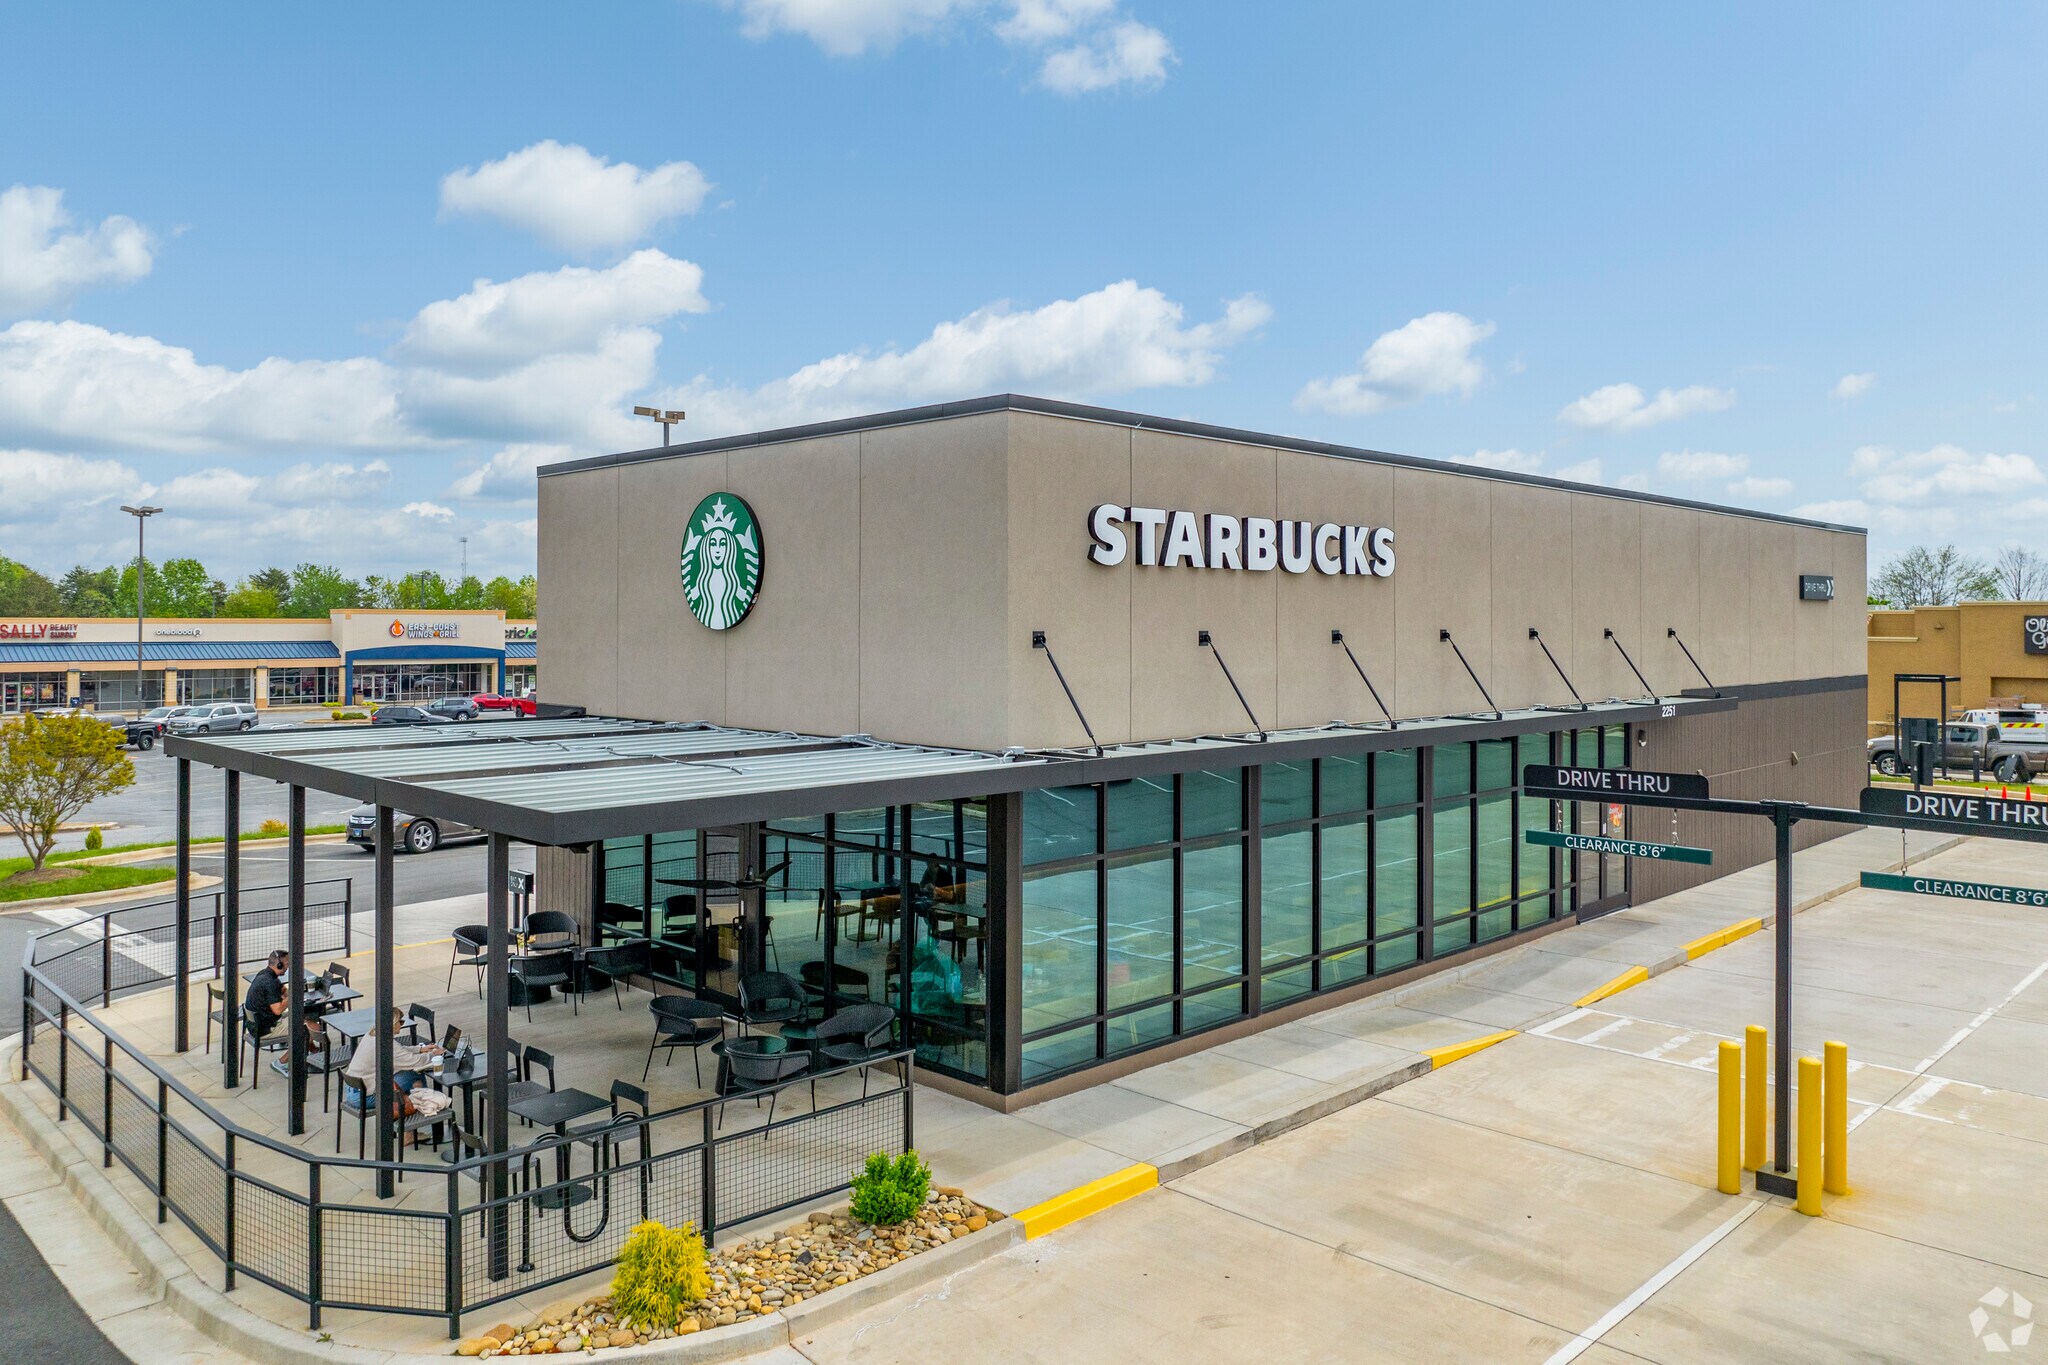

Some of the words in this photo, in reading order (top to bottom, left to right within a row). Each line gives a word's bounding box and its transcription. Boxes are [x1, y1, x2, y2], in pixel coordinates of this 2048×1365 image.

[1088, 503, 1396, 578] STARBUCKS
[0, 624, 47, 639] SALLY
[50, 631, 77, 639] SUPPLY
[408, 623, 429, 631] EAST
[433, 623, 459, 631] COAST
[2032, 631, 2048, 649] G
[1662, 705, 1676, 717] 2251
[1558, 769, 1612, 789] DRIVE
[1616, 773, 1670, 793] THRU
[1906, 794, 1979, 819] DRIVE
[1565, 836, 1637, 855] CLEARANCE
[1639, 845, 1666, 858] 8'6"
[1913, 879, 2011, 902] CLEARANCE
